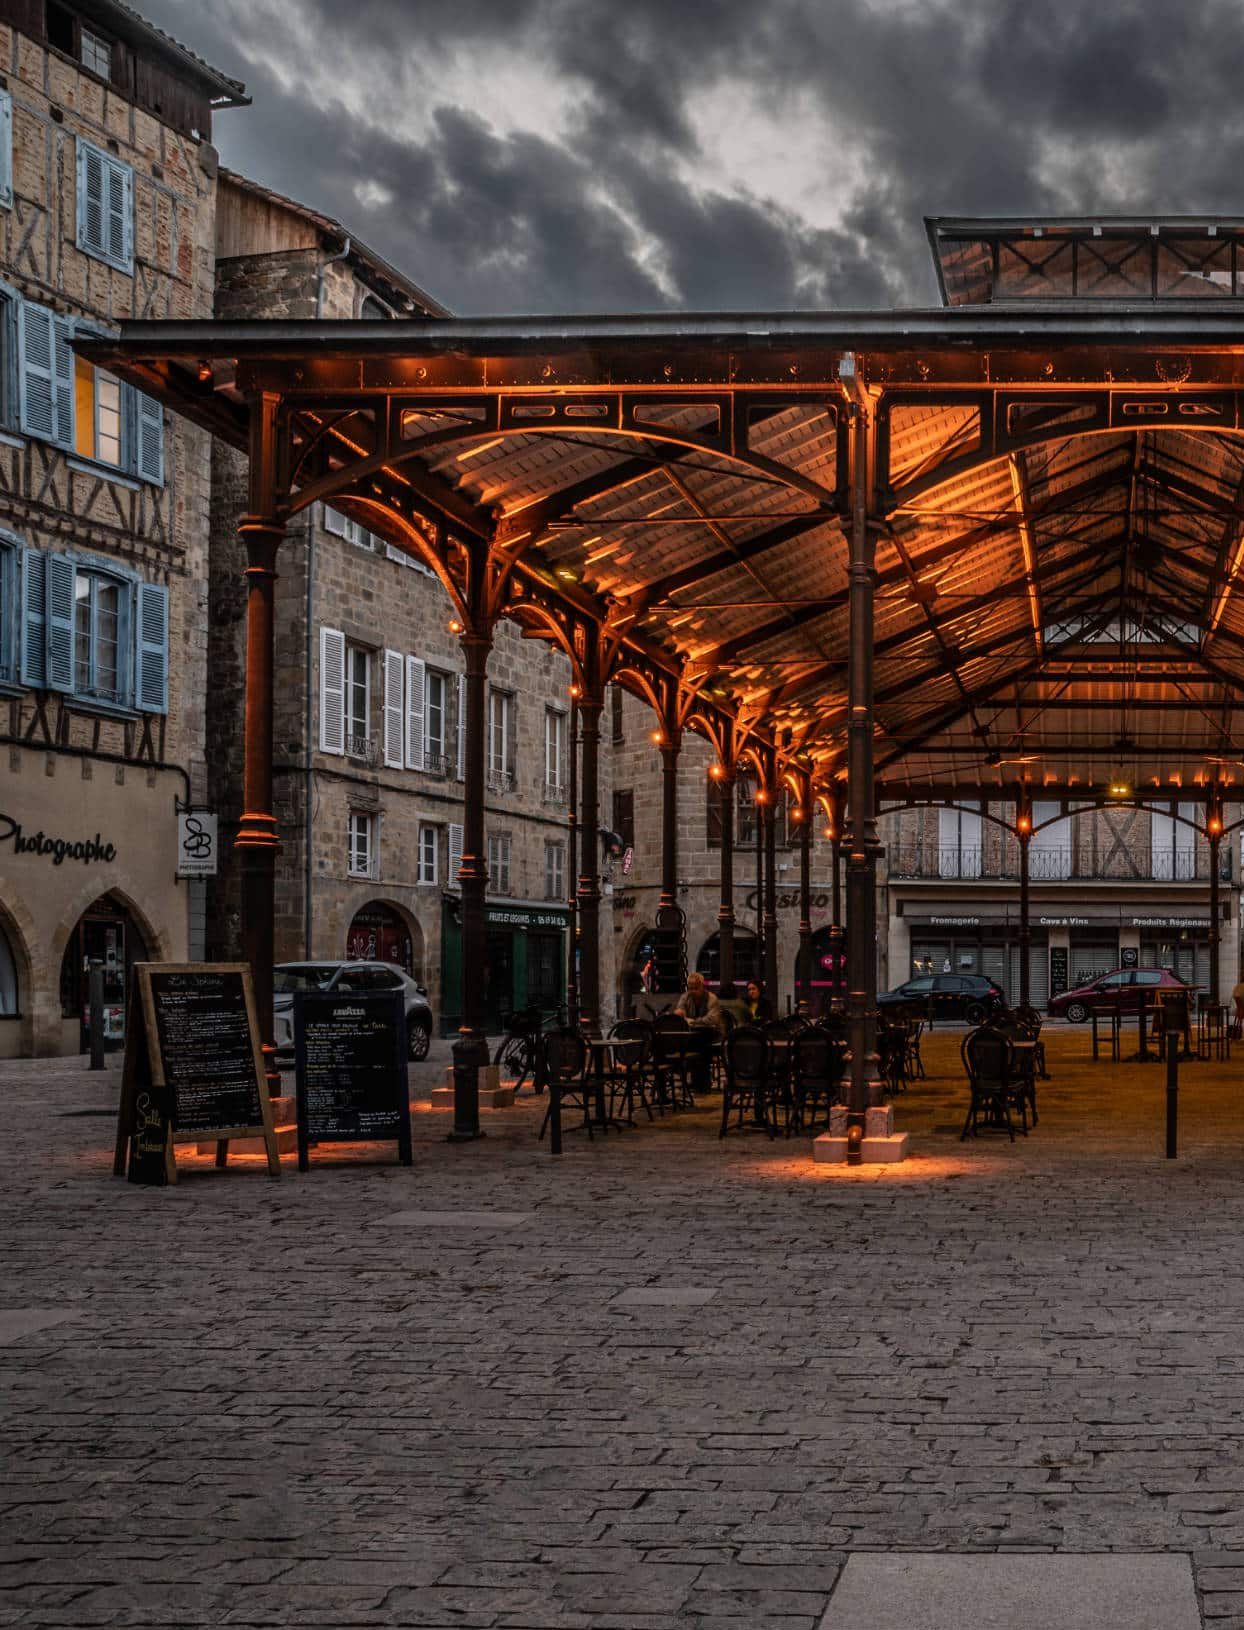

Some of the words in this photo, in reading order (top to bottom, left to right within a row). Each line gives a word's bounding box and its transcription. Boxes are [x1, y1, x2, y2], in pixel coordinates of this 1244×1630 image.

[930, 917, 980, 927] Fromagerie
[1040, 917, 1061, 925] Cave
[1070, 917, 1089, 925] Vins
[1133, 918, 1167, 926] Produits
